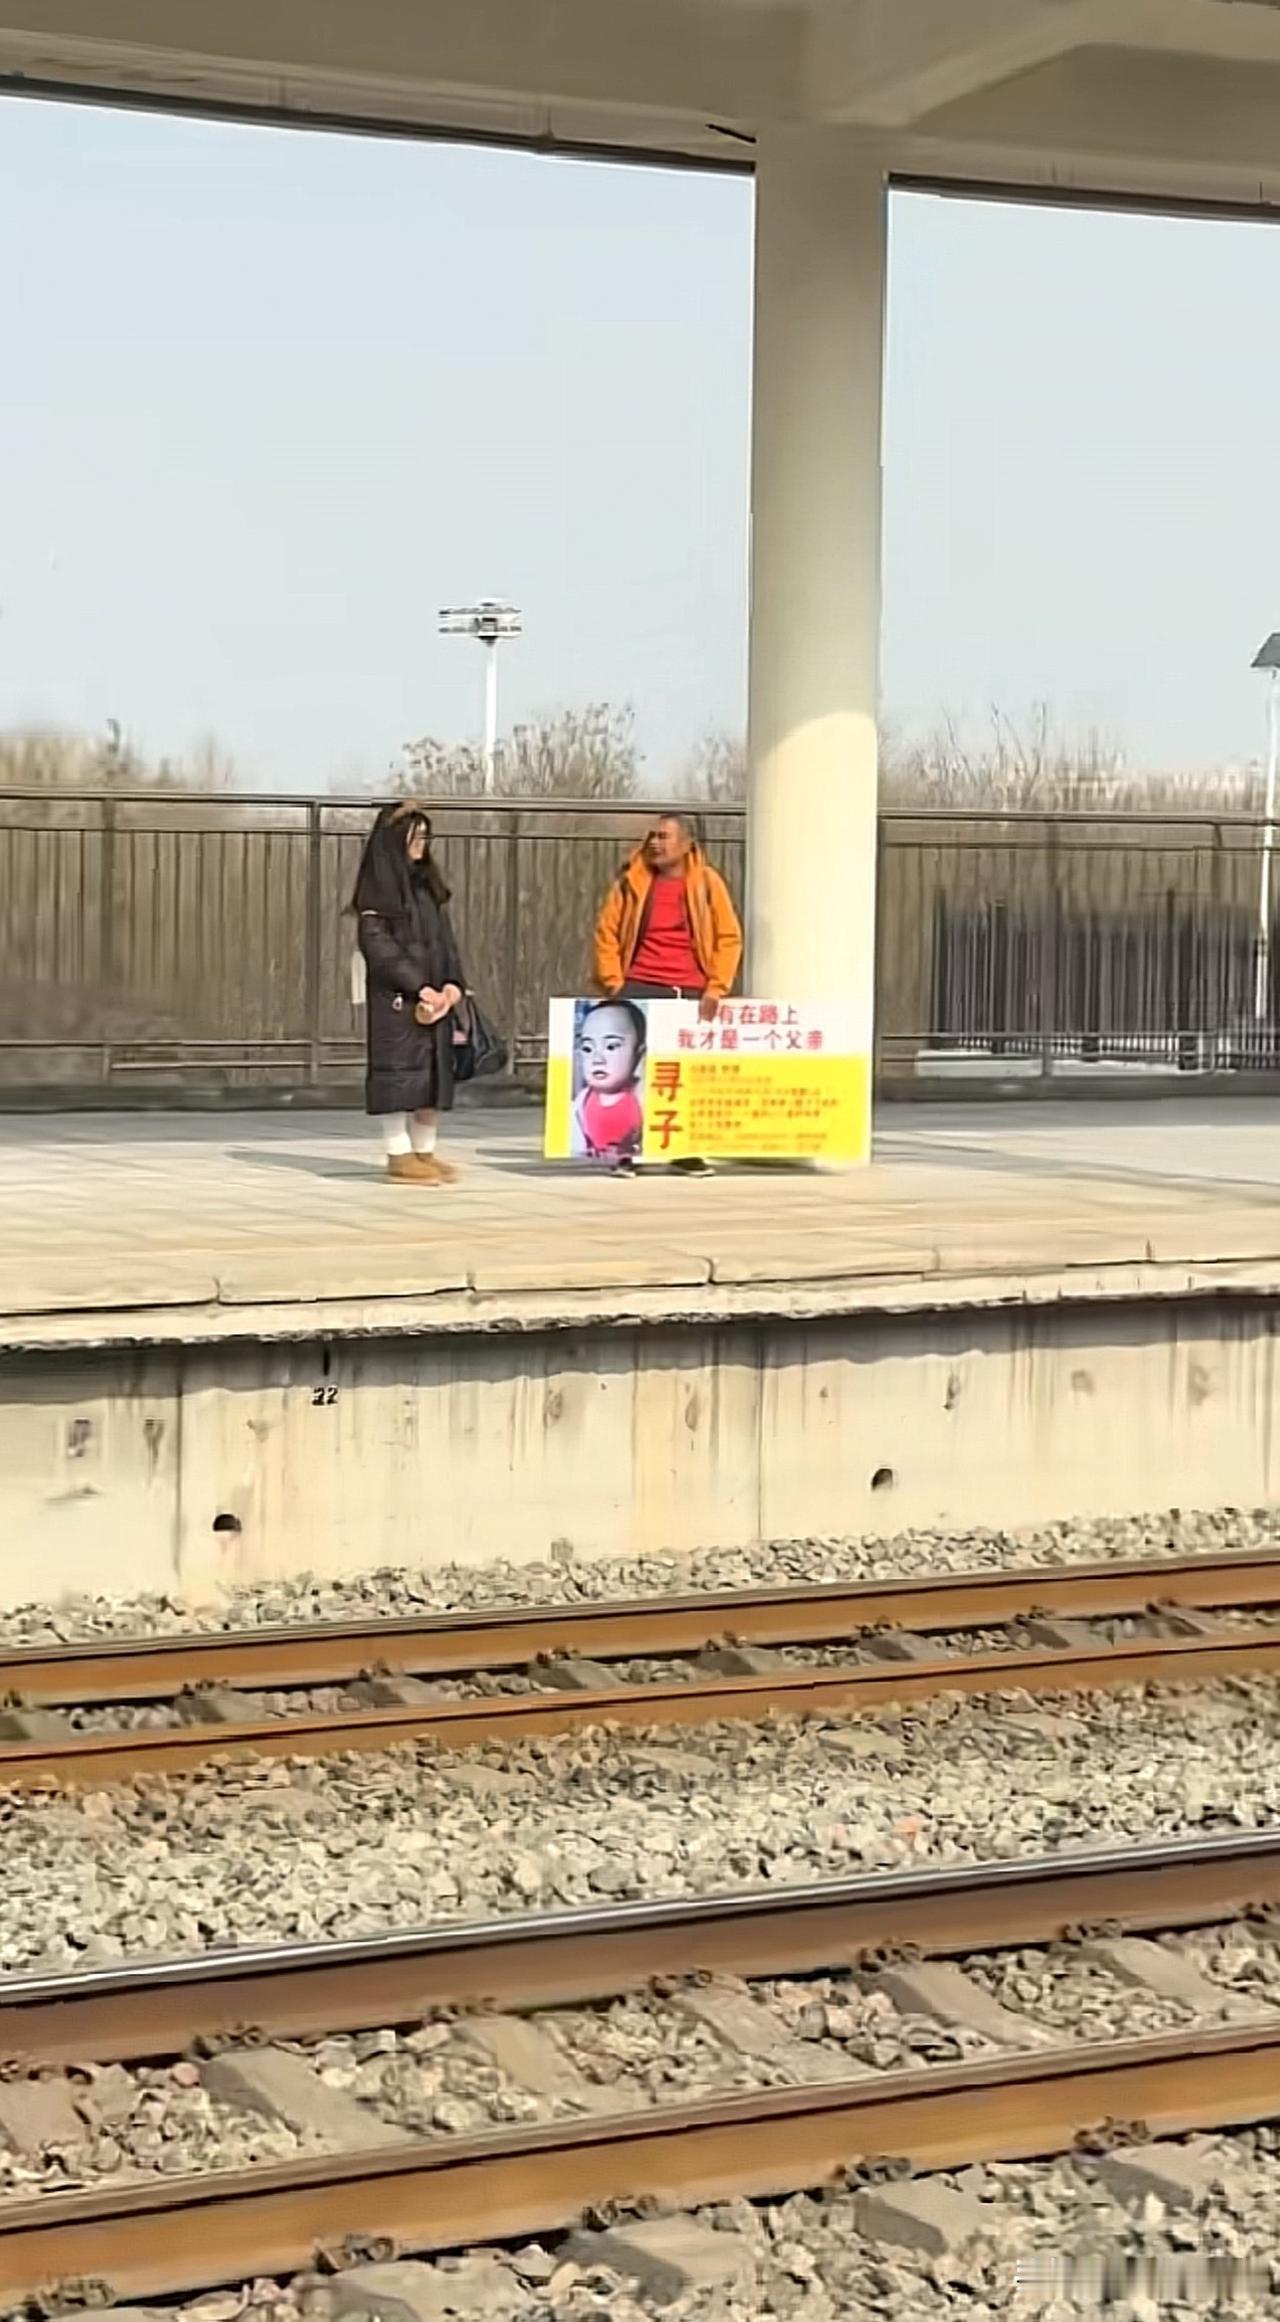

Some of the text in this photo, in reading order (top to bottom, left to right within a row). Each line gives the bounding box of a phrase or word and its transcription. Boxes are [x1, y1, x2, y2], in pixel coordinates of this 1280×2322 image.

[697, 1004, 799, 1025] 有在路上
[678, 1029, 824, 1050] 我才是一个父亲
[649, 1062, 683, 1149] 寻子
